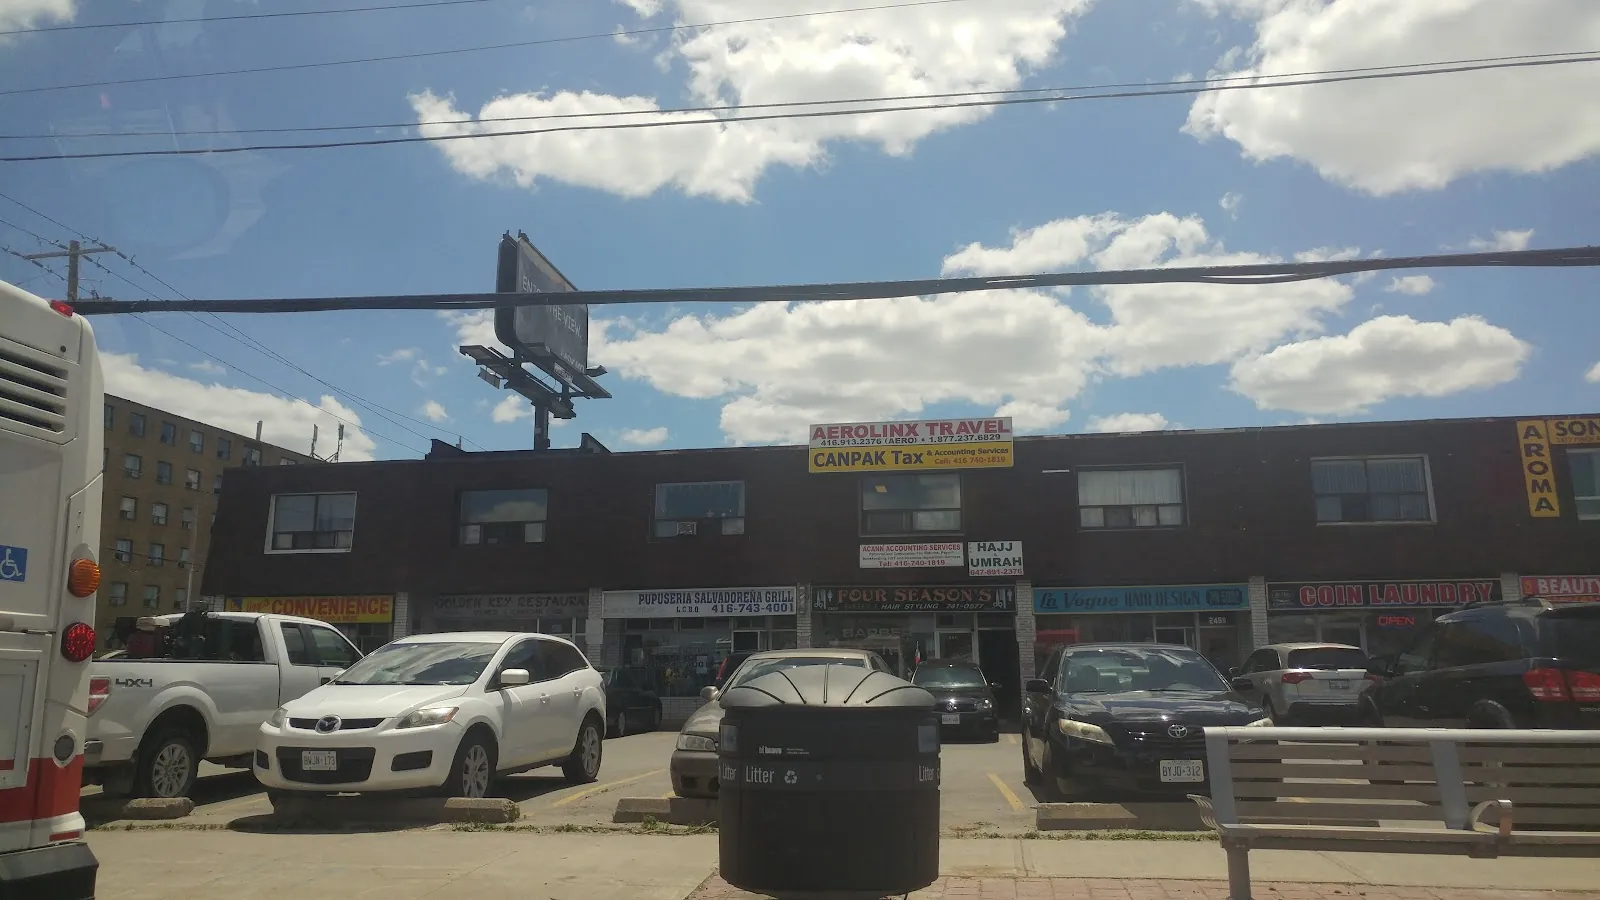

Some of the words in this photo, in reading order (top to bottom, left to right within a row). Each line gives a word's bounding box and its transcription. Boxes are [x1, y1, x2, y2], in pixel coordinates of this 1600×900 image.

[812, 423, 919, 440] AEROLINX
[925, 420, 1011, 436] TRAVEL
[820, 438, 882, 446] 416.913.2376
[885, 437, 917, 445] (AERO)
[929, 434, 1001, 442] 1.877.237.6829
[813, 451, 887, 467] CANPAK
[891, 450, 924, 465] Tax
[1523, 425, 1556, 512] AROMA
[886, 544, 928, 552] ACCOUNTING
[929, 543, 961, 551] SERVICES
[977, 542, 1013, 552] HAJJ
[894, 559, 946, 567] 416-740-1819
[970, 556, 1022, 567] UMRAH
[970, 568, 1023, 576] 647-891-2376
[489, 596, 512, 607] KEY
[638, 592, 692, 605] PUPUSERIA
[694, 589, 763, 604] SALVADOREÑA
[765, 590, 794, 602] GRILL
[838, 588, 887, 603] FOUR
[894, 587, 992, 602] SEASON'S
[1064, 592, 1119, 609] Vogue
[1124, 591, 1152, 607] HAIR
[1156, 591, 1200, 606] DESIGN
[1299, 585, 1364, 606] COIN
[1369, 582, 1493, 605] LAUNDRY
[272, 597, 389, 614] CONVENIENCE
[711, 603, 794, 613] 416-743-4001
[1377, 616, 1415, 626] OPEN
[722, 763, 737, 781] Litter
[745, 765, 775, 784] Litter
[918, 765, 936, 782] Litter
